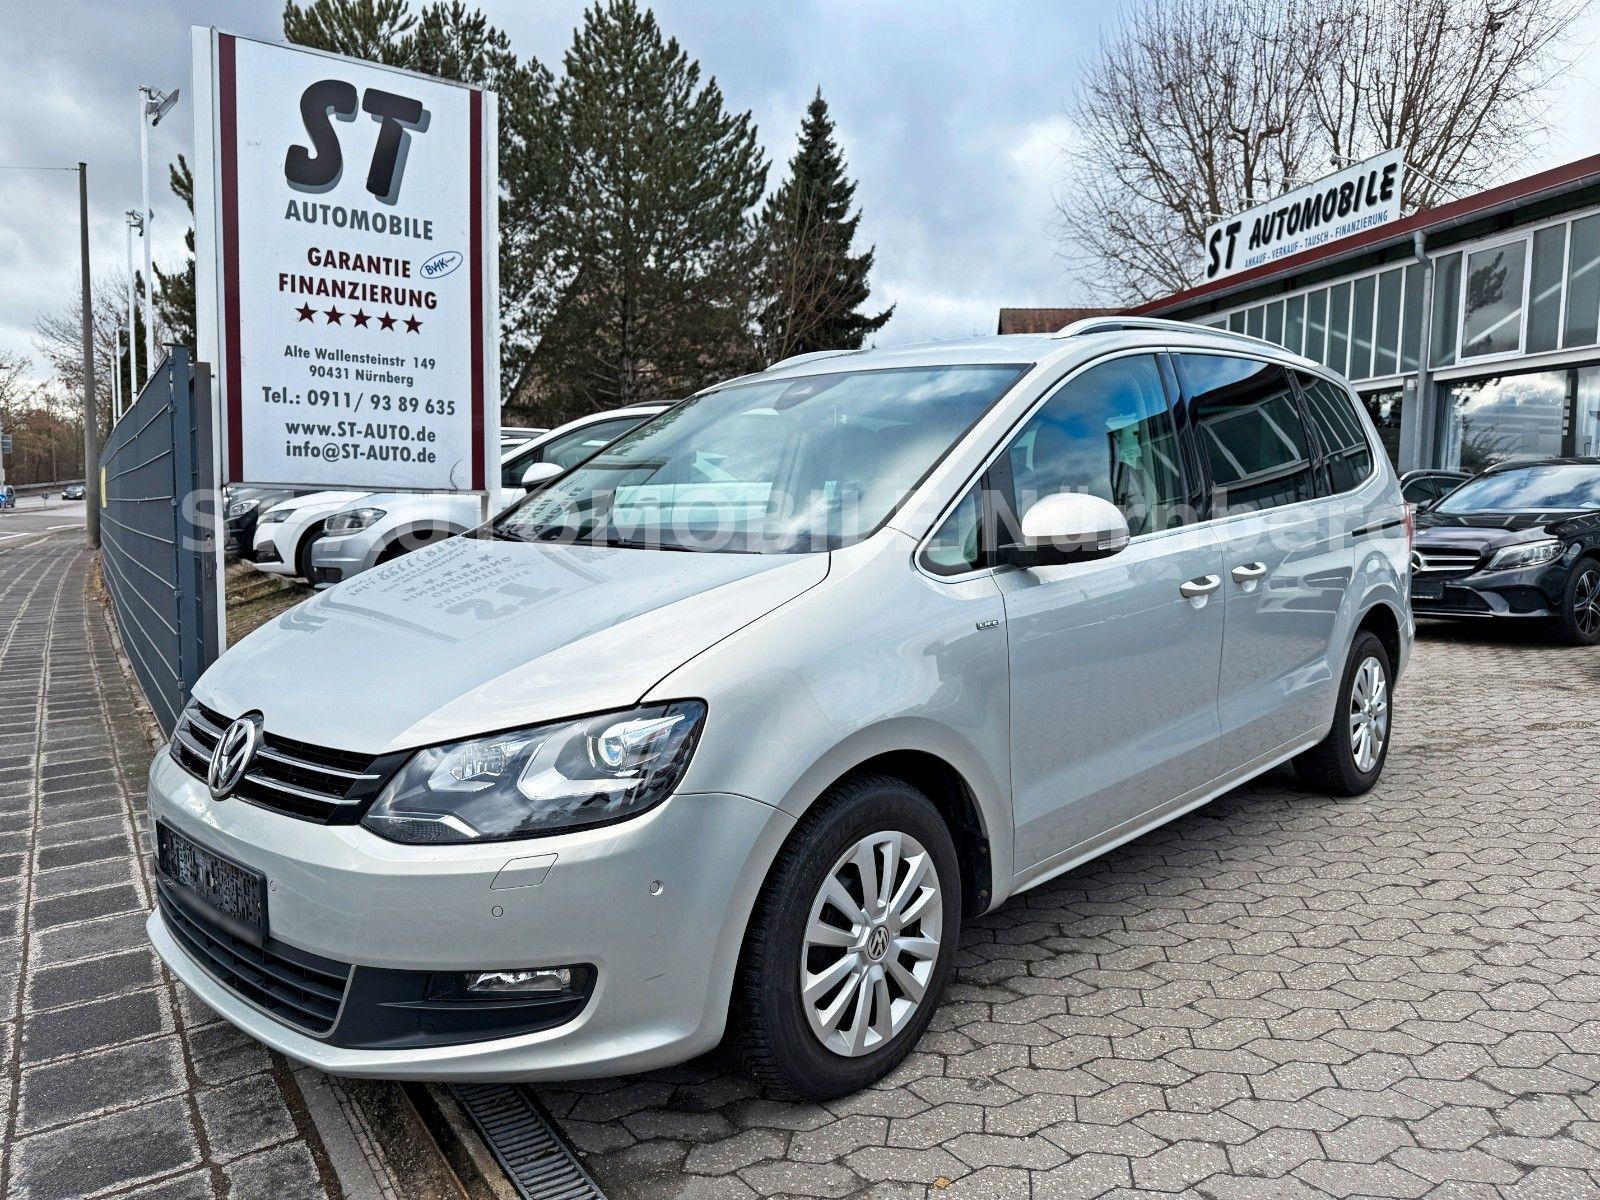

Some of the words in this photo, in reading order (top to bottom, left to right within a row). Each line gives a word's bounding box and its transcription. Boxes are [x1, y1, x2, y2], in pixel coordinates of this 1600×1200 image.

[284, 79, 431, 206] ST
[284, 199, 433, 241] AUTOMOBILE
[1207, 220, 1242, 279] ST
[1248, 162, 1398, 250] AUTOMOBILE
[1245, 252, 1267, 268] ANKAUF
[1272, 241, 1299, 259] VERKAUF
[1304, 231, 1329, 248] TAUSCH
[1335, 210, 1388, 237] FINANZIERUNG
[307, 246, 411, 278] GARANTIE
[278, 272, 437, 310] FINANZIERUNG
[284, 345, 310, 359] Alte
[315, 347, 406, 367] Wallensteinstr
[413, 357, 436, 370] 149
[309, 364, 350, 380] 90431
[355, 368, 414, 387] Nürnberg
[262, 386, 301, 405] Tel.:
[370, 394, 392, 411] 93
[398, 396, 419, 412] 89
[425, 398, 455, 416] 635
[285, 421, 436, 442] www.ST-AUTO.de
[285, 440, 436, 463] info@ST-AUTO.de
